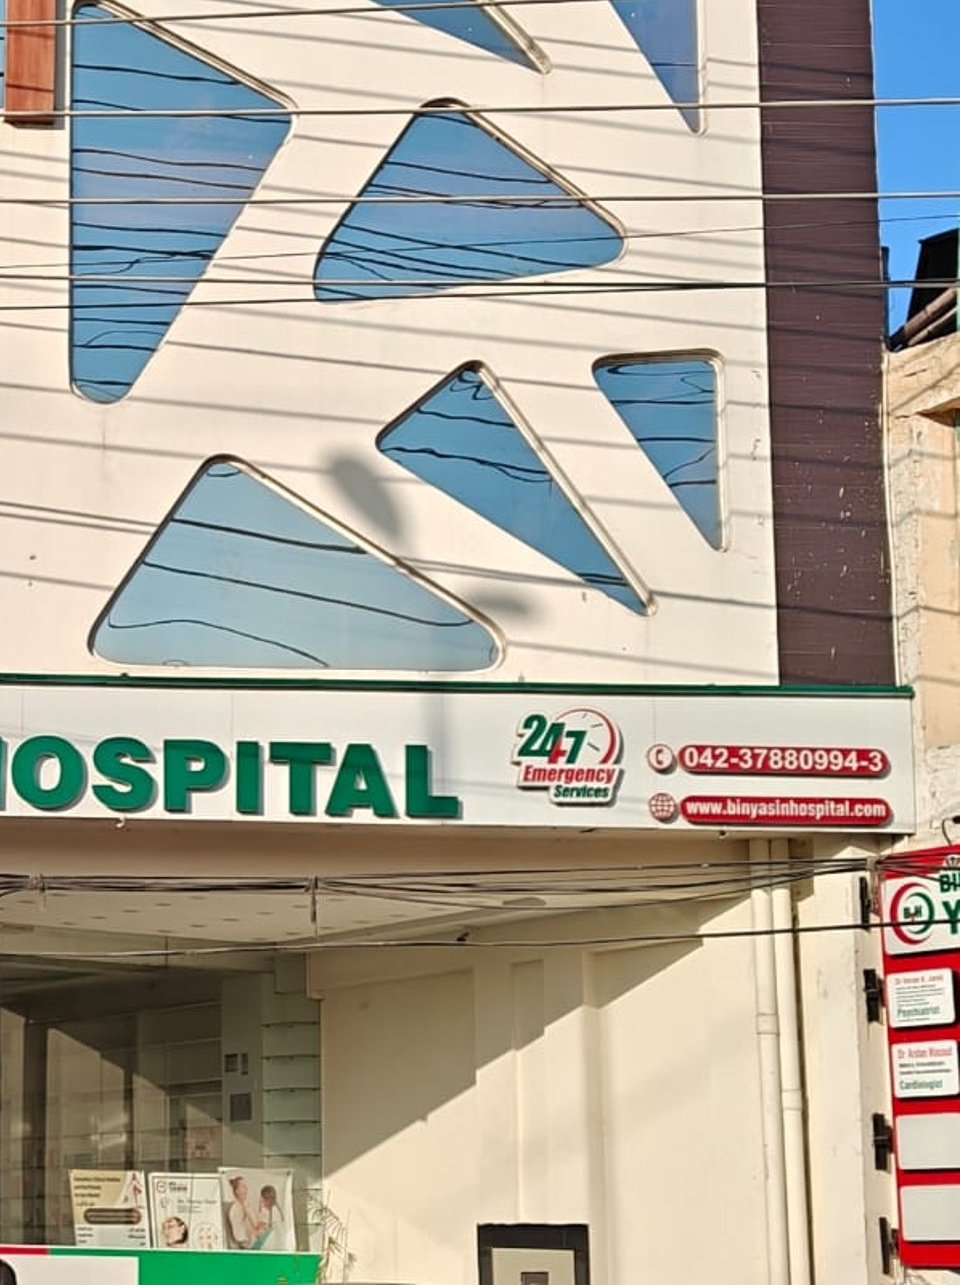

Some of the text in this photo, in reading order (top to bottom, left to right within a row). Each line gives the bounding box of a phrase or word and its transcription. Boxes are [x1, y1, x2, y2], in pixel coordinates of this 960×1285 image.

[684, 746, 883, 772] 042-37880994-3
[522, 764, 616, 785] Emergency
[553, 784, 610, 799] Services
[686, 798, 887, 821] www.binyasinhospital.com
